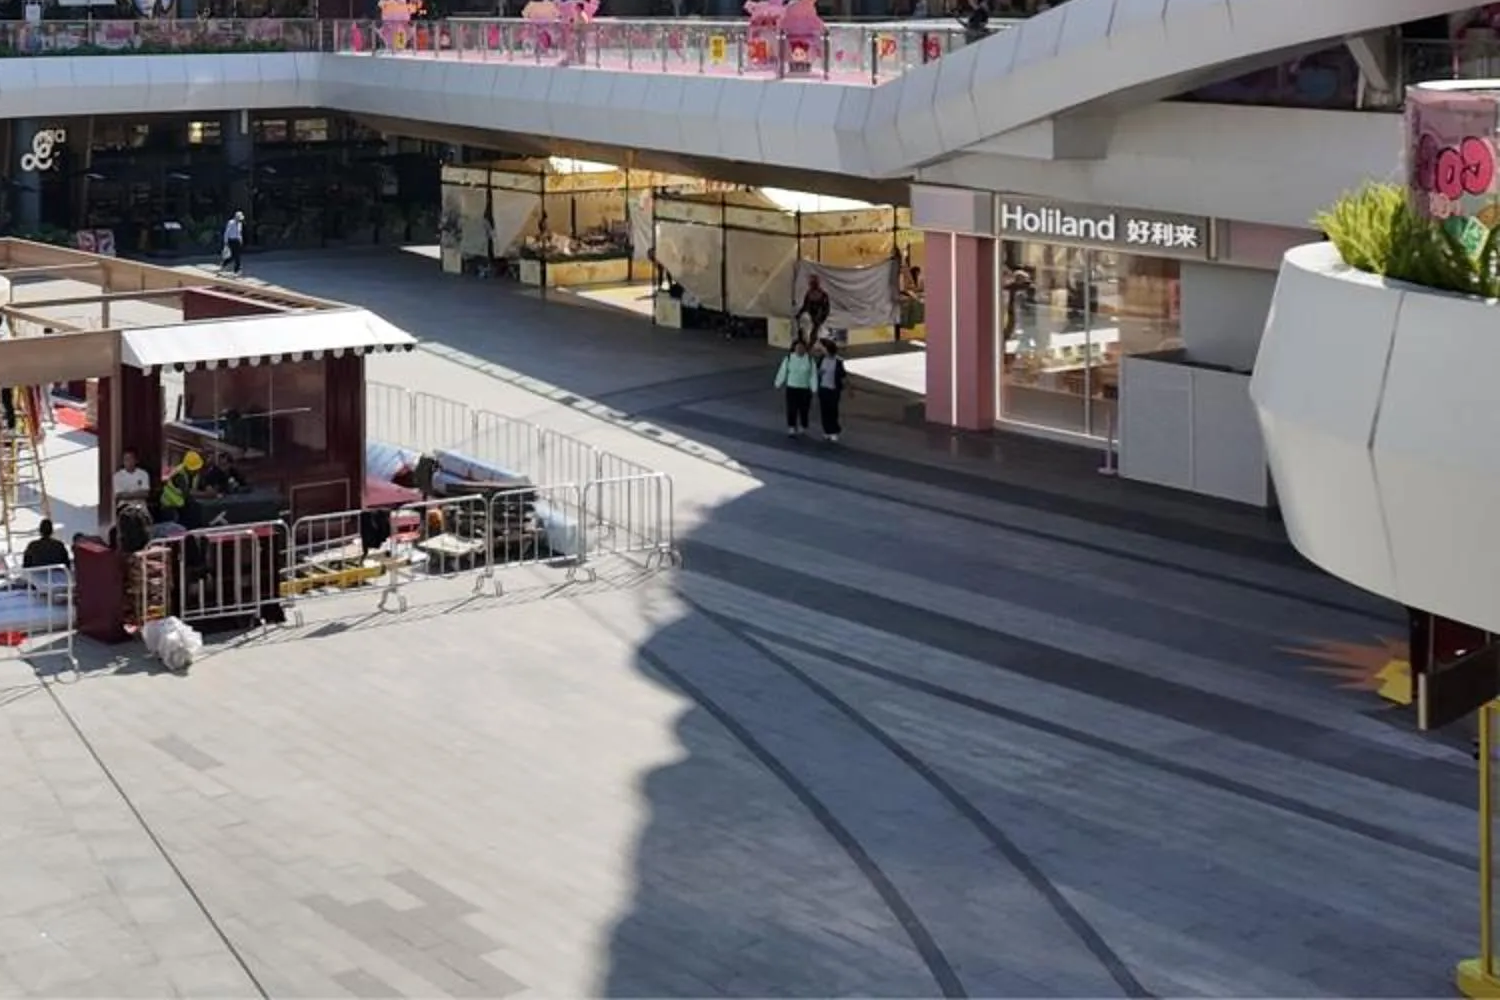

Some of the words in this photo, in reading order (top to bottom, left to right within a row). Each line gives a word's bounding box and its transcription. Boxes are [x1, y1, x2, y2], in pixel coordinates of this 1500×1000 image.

[1001, 203, 1116, 240] Holiland
[1127, 219, 1199, 247] 好利来
